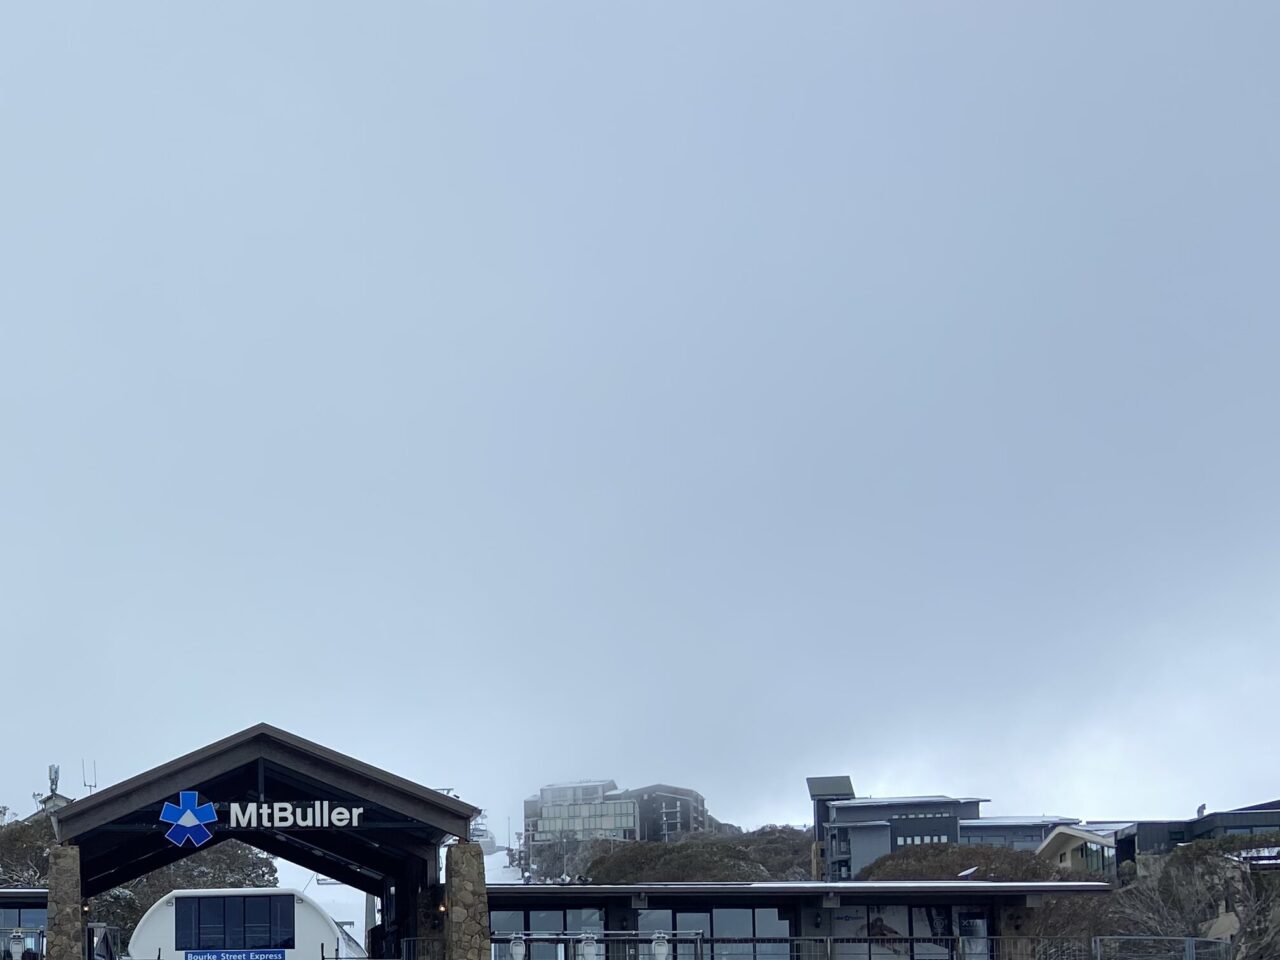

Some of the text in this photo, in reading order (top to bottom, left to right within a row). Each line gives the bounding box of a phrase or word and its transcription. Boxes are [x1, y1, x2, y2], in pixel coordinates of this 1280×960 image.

[230, 801, 363, 828] MtBuller
[187, 952, 282, 960] Bourke Street Express
